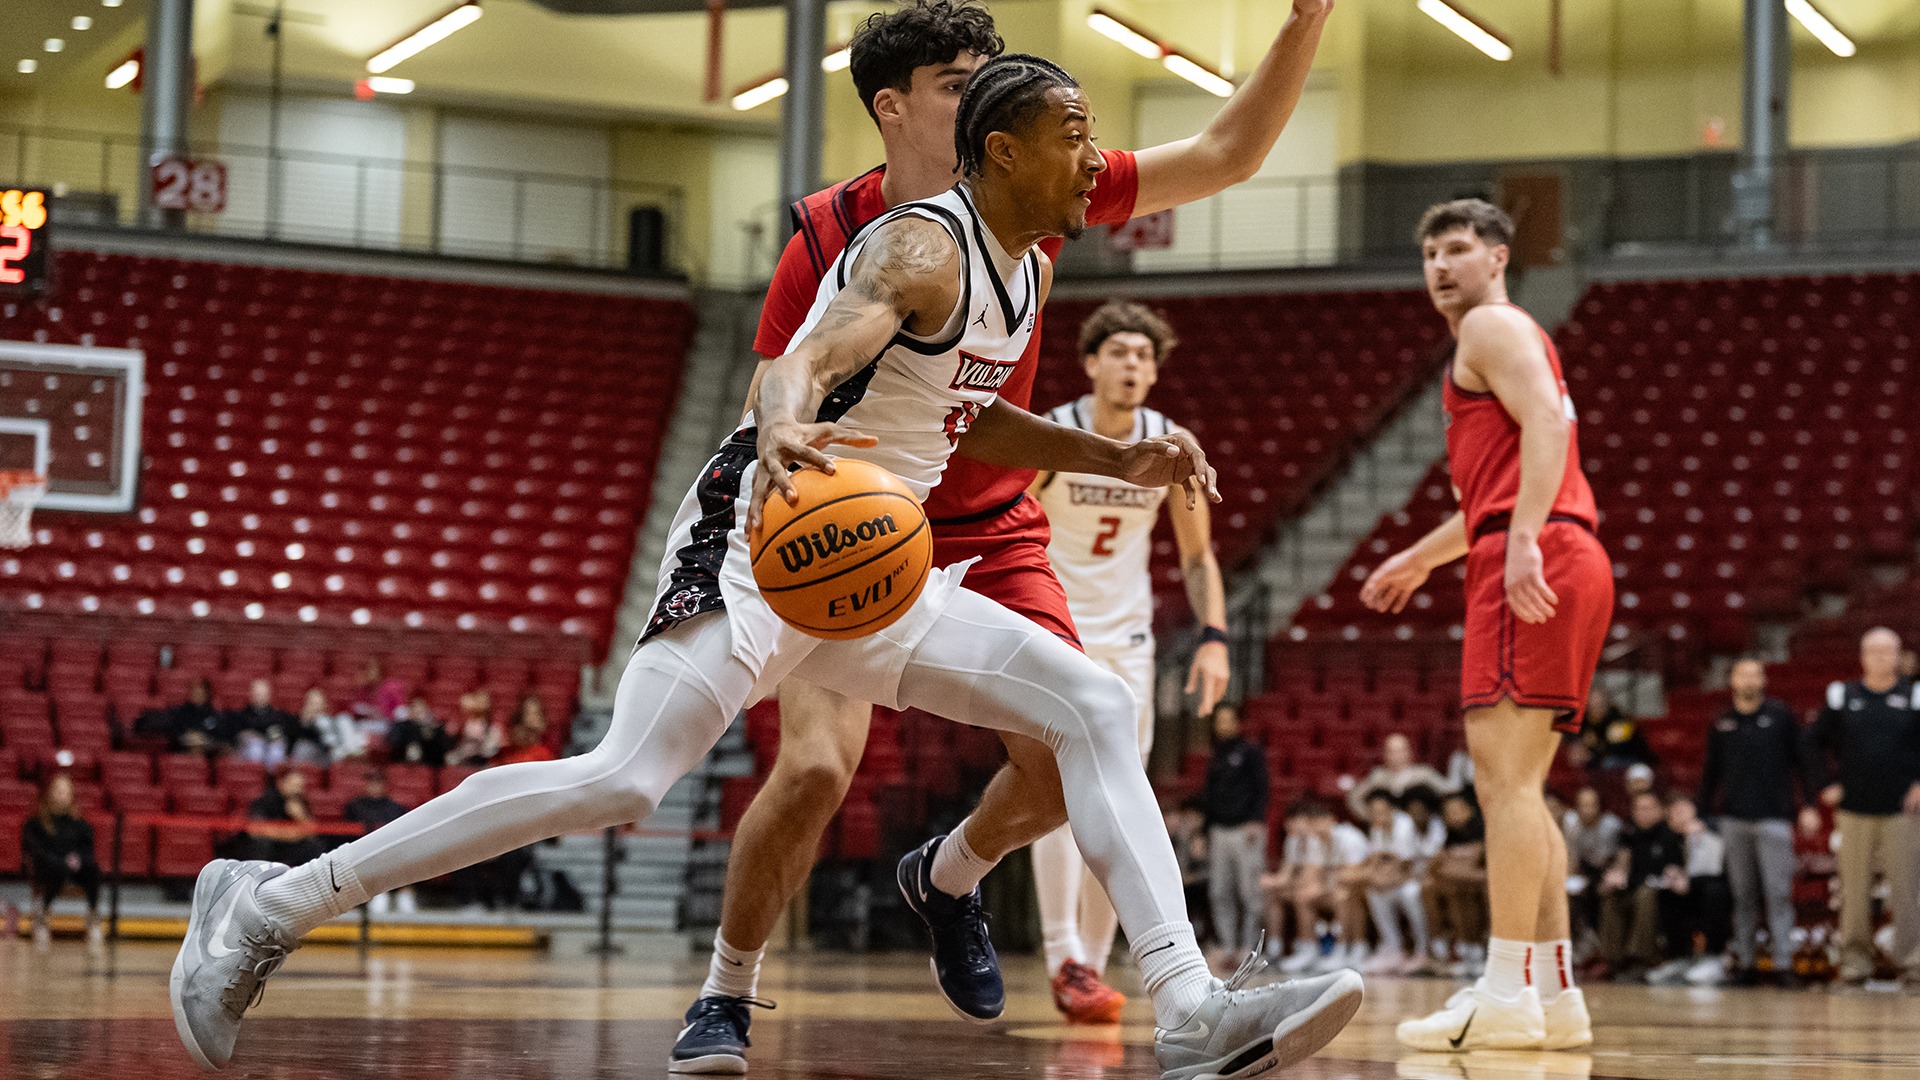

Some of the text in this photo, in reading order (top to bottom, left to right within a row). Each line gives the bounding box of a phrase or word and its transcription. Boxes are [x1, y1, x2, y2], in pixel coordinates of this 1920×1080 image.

[155, 159, 222, 214] 28
[776, 513, 899, 574] Wilson
[1091, 516, 1122, 556] 2
[827, 573, 893, 618] EVO
[893, 557, 910, 579] NXT
